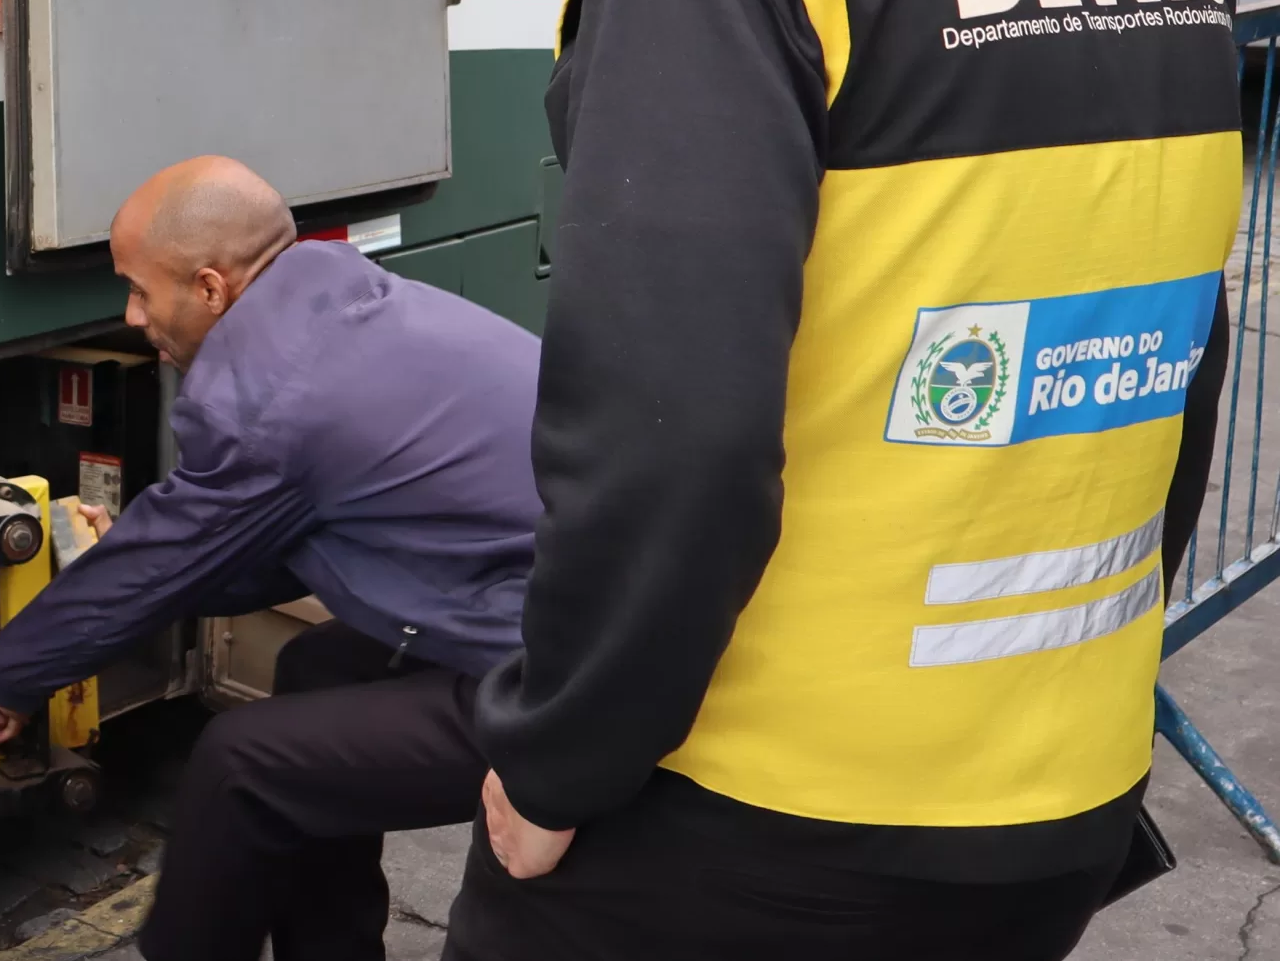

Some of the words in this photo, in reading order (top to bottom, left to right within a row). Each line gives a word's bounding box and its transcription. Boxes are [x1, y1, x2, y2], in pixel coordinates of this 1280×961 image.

[942, 14, 1060, 50] Departamento
[1062, 13, 1083, 32] de
[1082, 8, 1164, 34] Transportes
[1035, 334, 1134, 370] GOVERNO
[1138, 330, 1163, 353] DO
[1028, 369, 1086, 416] Rio
[1092, 363, 1139, 405] de
